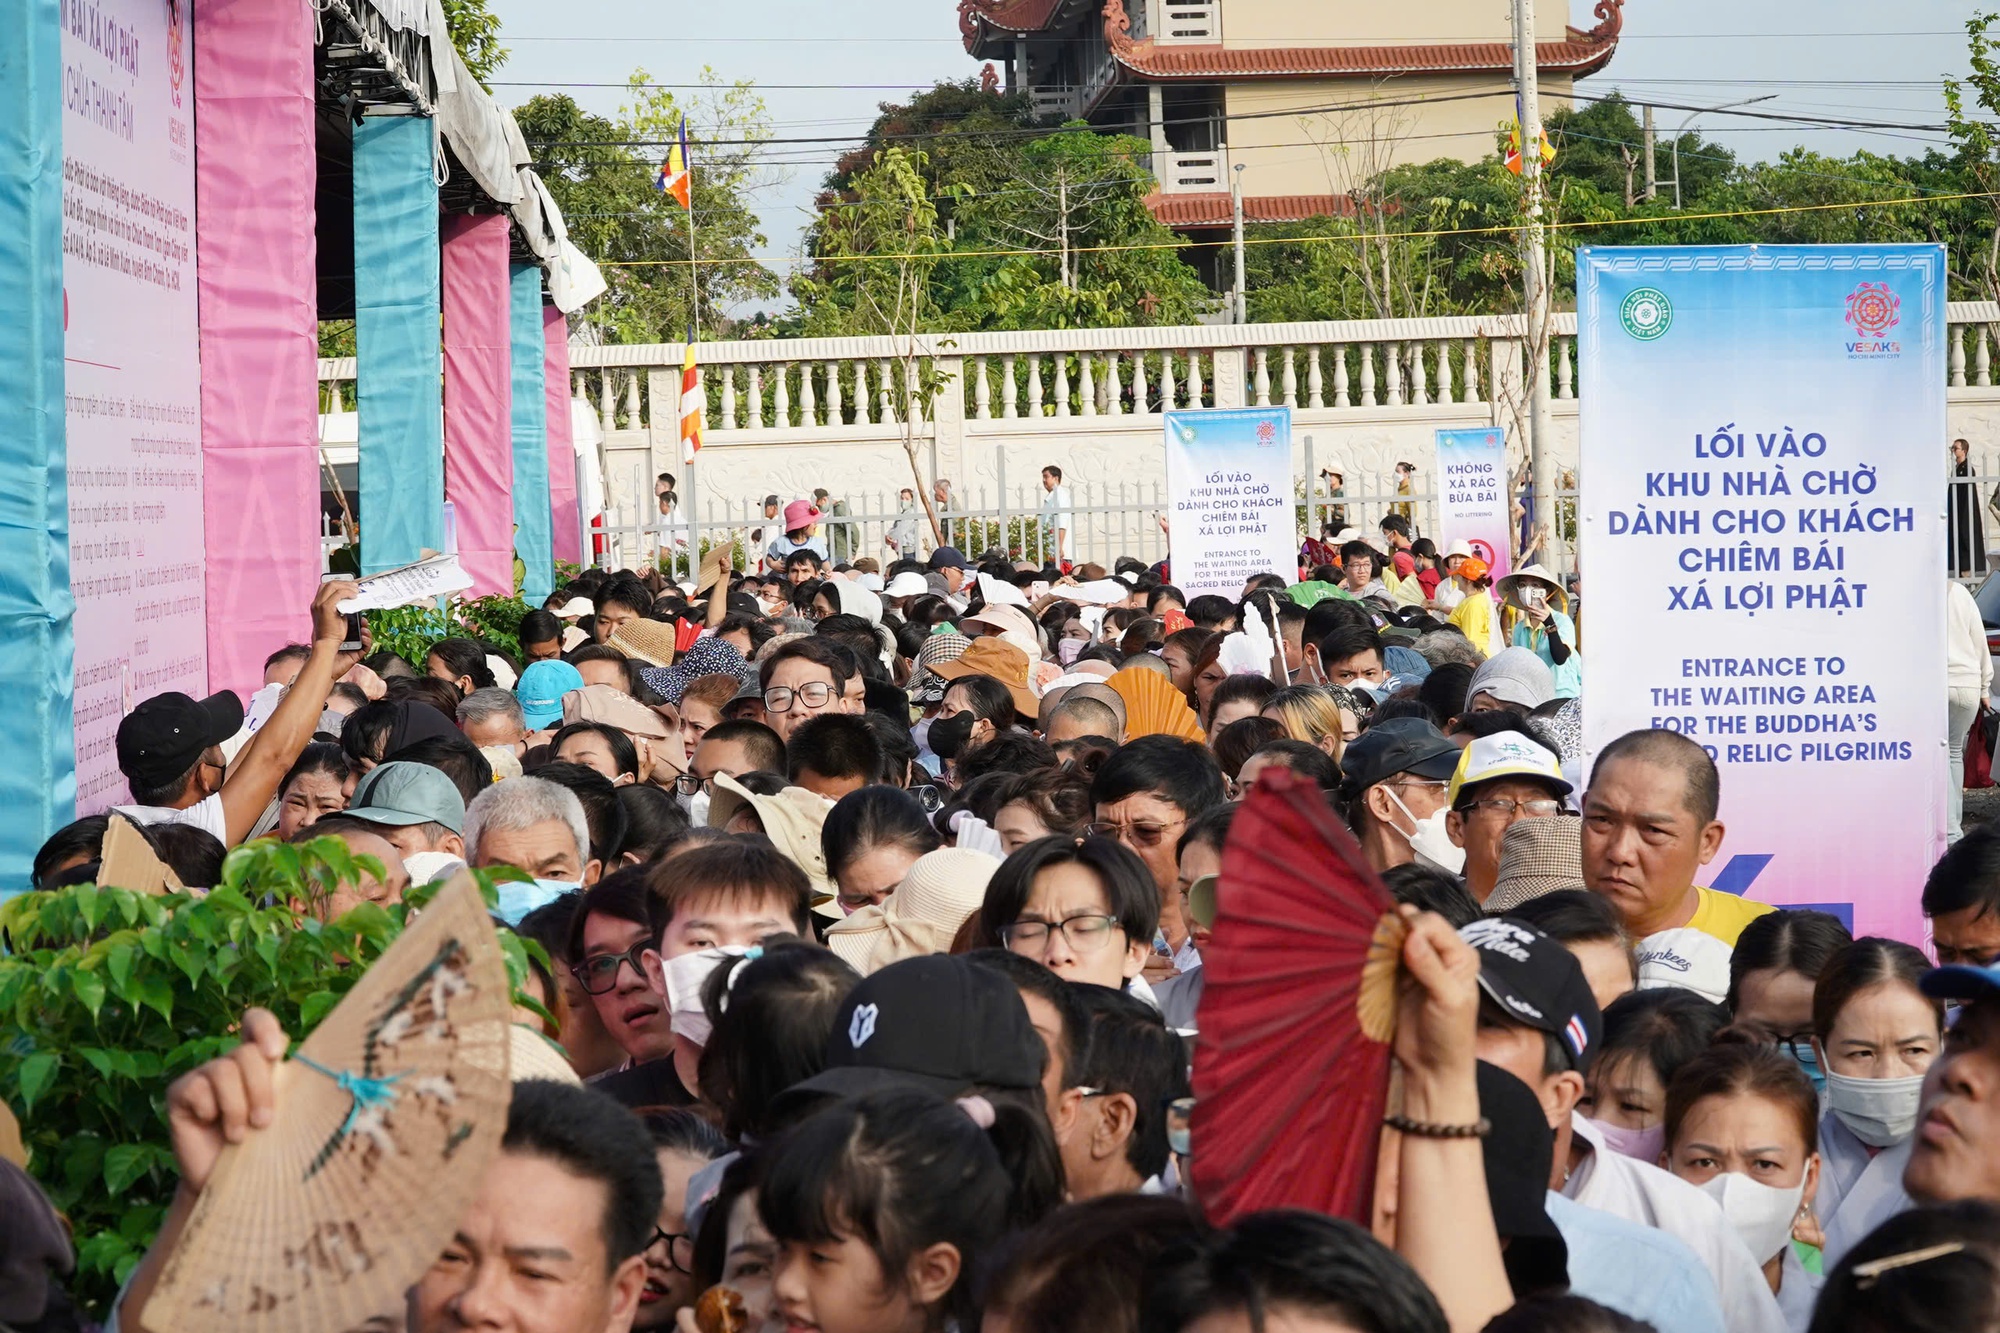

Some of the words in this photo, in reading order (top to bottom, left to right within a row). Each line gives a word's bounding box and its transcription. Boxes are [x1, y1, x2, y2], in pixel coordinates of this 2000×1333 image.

[1631, 293, 1643, 302] HỘI
[1645, 292, 1661, 302] PHẬT
[1660, 303, 1668, 319] GIÁO
[1631, 326, 1645, 335] VIỆT
[1647, 326, 1661, 335] NAM
[1695, 422, 1744, 458] LỐI
[1756, 426, 1827, 458] VÀO
[1448, 462, 1492, 474] KHÔNG
[1206, 471, 1223, 483] LỐI
[1227, 471, 1252, 482] VÀO
[1449, 476, 1466, 488] XẢ
[1470, 476, 1495, 488] RÁC
[1646, 472, 1710, 496] KHU
[1723, 464, 1791, 496] NHÀ
[1802, 463, 1877, 495] CHỜ
[1190, 488, 1212, 497] KHU
[1216, 484, 1239, 496] NHÀ
[1244, 483, 1269, 494] CHỜ
[1449, 491, 1473, 503] BỪA
[1477, 490, 1497, 501] BÃI
[1178, 500, 1209, 510] DÀNH
[1213, 500, 1238, 509] CHO
[1243, 496, 1282, 508] KHÁCH
[1202, 511, 1237, 522] CHIÊM
[1242, 509, 1259, 520] BÁI
[1609, 503, 1700, 535] DÀNH
[1712, 509, 1785, 534] CHO
[1799, 501, 1914, 533] KHÁCH
[1199, 524, 1214, 536] XÁ
[1218, 525, 1235, 537] LỢI
[1240, 523, 1267, 536] PHẬT
[1205, 550, 1247, 558] ENTRANCE
[1679, 540, 1780, 572] CHIÊM
[1793, 539, 1844, 571] BÁI
[1211, 560, 1247, 568] WAITING
[1213, 570, 1228, 578] THE
[1667, 579, 1713, 610] XÁ
[1725, 581, 1773, 616] LỢI
[1786, 577, 1867, 615] PHẬT
[1682, 658, 1806, 678] ENTRANCE
[1814, 656, 1845, 675] TO
[1651, 687, 1692, 706] THE
[1700, 686, 1805, 706] WAITING
[1814, 685, 1876, 704] AREA
[1652, 716, 1697, 735] FOR
[1705, 716, 1747, 734] THE
[1727, 744, 1792, 763] RELIC
[1801, 741, 1912, 762] PILGRIMS
